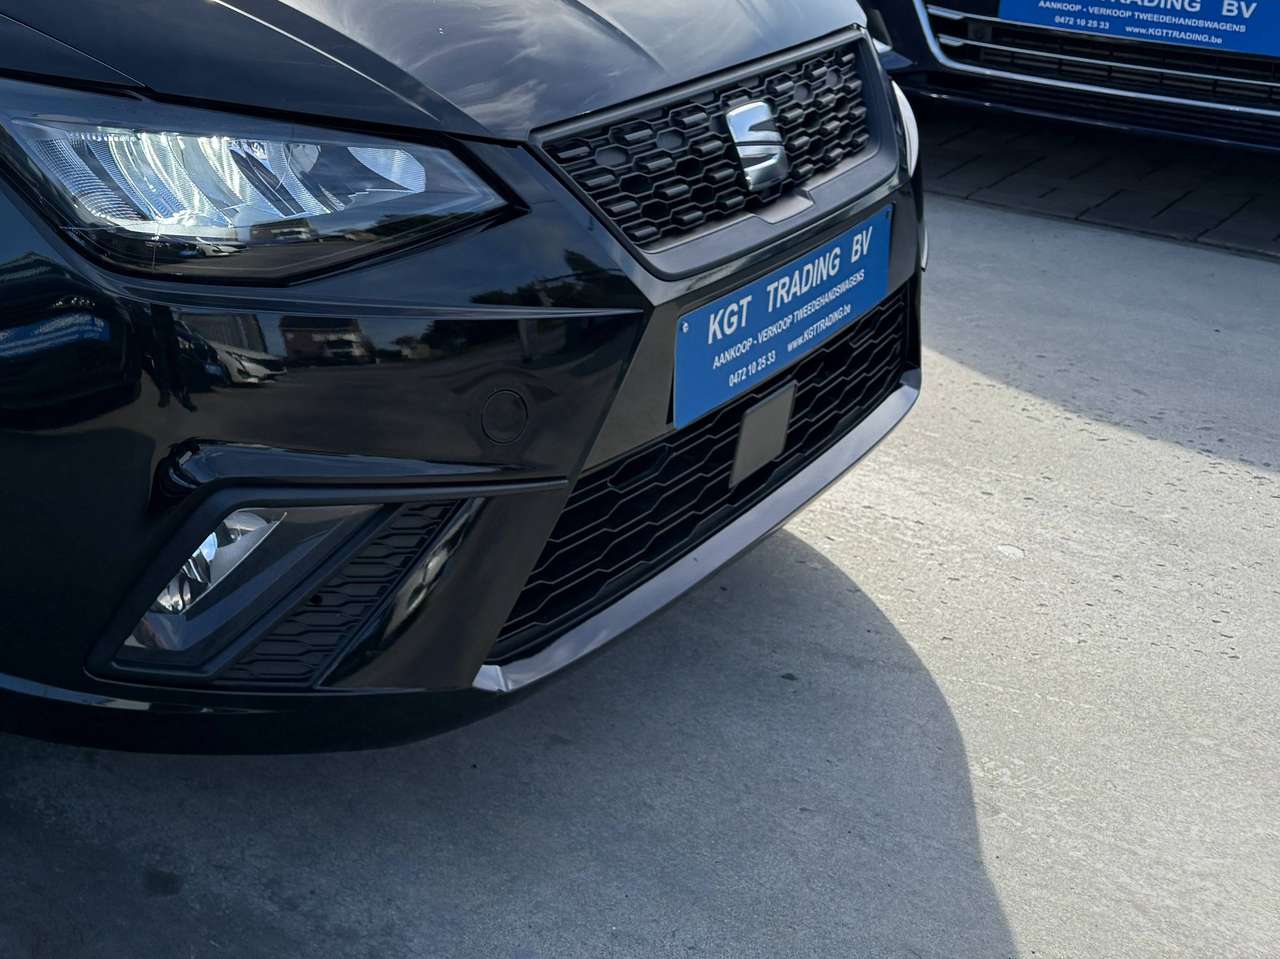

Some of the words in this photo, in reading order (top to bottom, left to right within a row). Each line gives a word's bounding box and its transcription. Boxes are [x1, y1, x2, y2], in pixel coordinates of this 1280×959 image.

[1038, 0, 1082, 13] AANKOOP
[1087, 5, 1132, 19] VERKOOP
[1134, 11, 1246, 33] TWEEDEHANDSWAGENS
[1222, 0, 1257, 19] BV
[707, 294, 753, 345] KGT
[766, 246, 841, 313] TRADING
[851, 226, 874, 264] BV
[712, 337, 753, 370] AANKOOP
[757, 314, 794, 344] VERKOOP
[728, 367, 747, 387] 0472
[747, 361, 757, 376] 10
[757, 355, 767, 371] 25
[767, 349, 776, 365] 33
